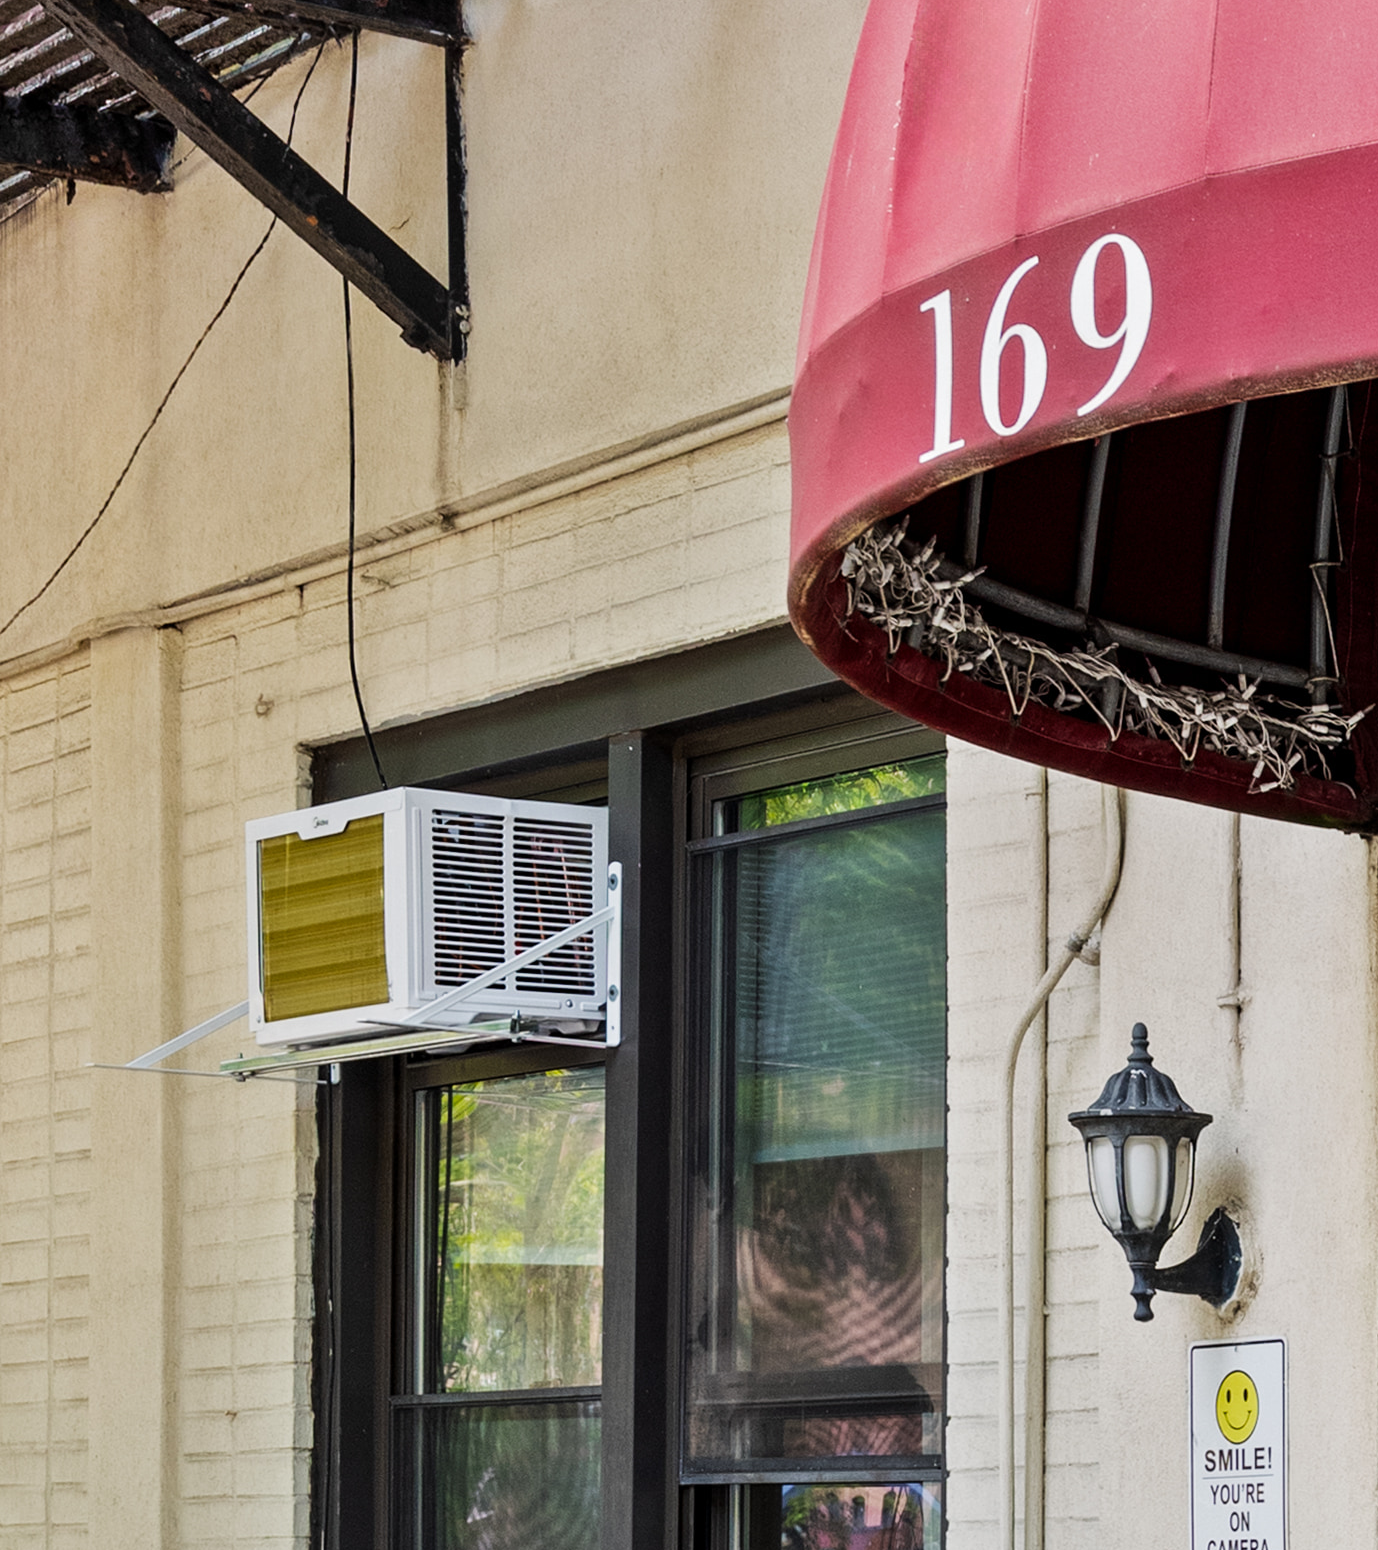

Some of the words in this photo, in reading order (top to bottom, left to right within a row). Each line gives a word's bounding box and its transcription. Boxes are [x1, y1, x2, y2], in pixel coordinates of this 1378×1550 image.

[918, 232, 1153, 464] 169
[1204, 1447, 1272, 1472] SMILE!
[1210, 1483, 1265, 1505] YOU'RE
[1229, 1511, 1250, 1532] ON
